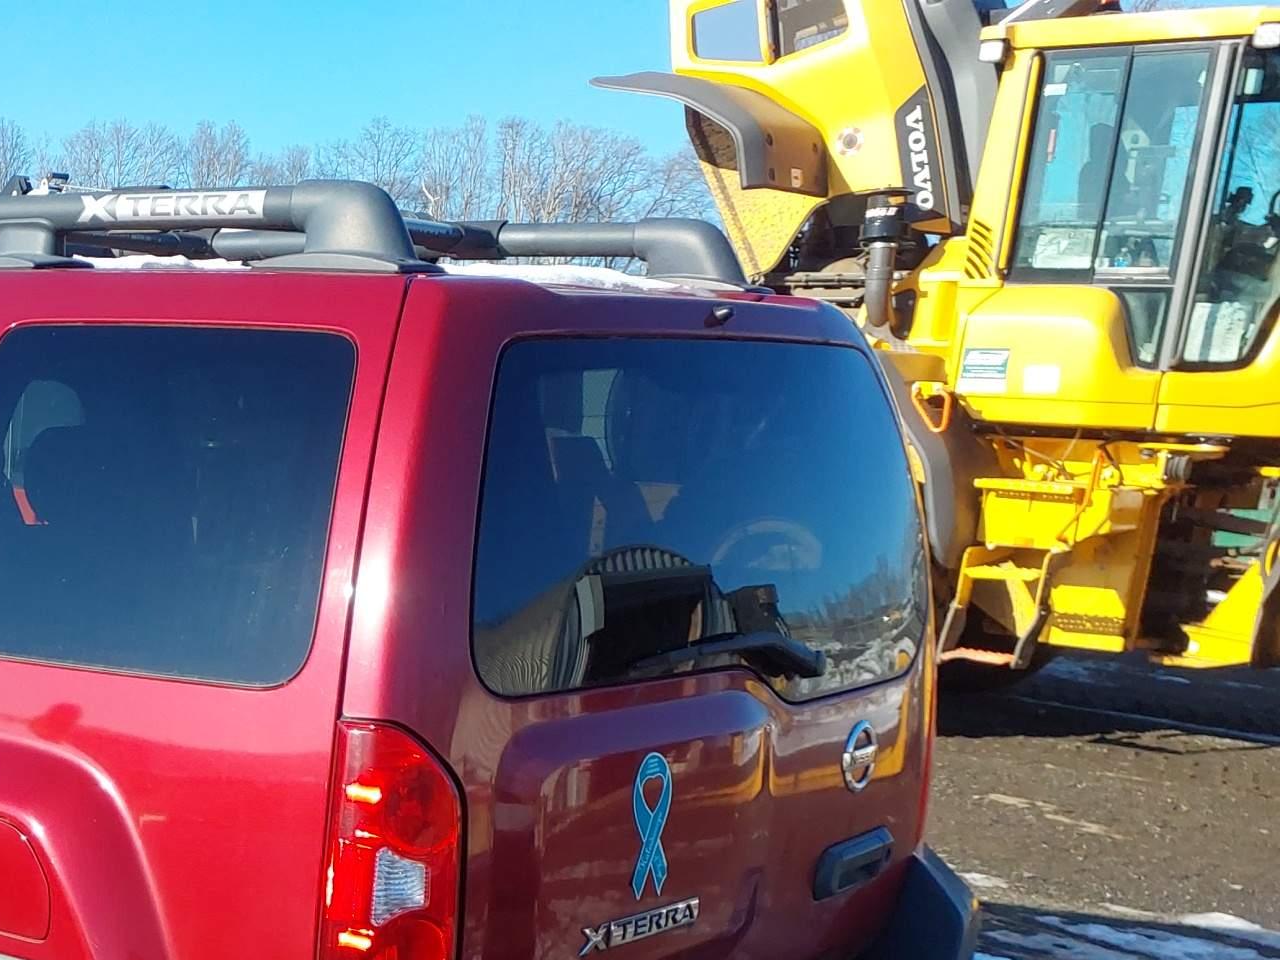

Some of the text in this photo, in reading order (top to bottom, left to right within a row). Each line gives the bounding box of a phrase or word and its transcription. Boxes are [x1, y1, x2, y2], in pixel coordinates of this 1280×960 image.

[904, 104, 934, 211] VOLVO
[77, 192, 258, 223] XTERRA
[577, 899, 698, 957] XTERRA
